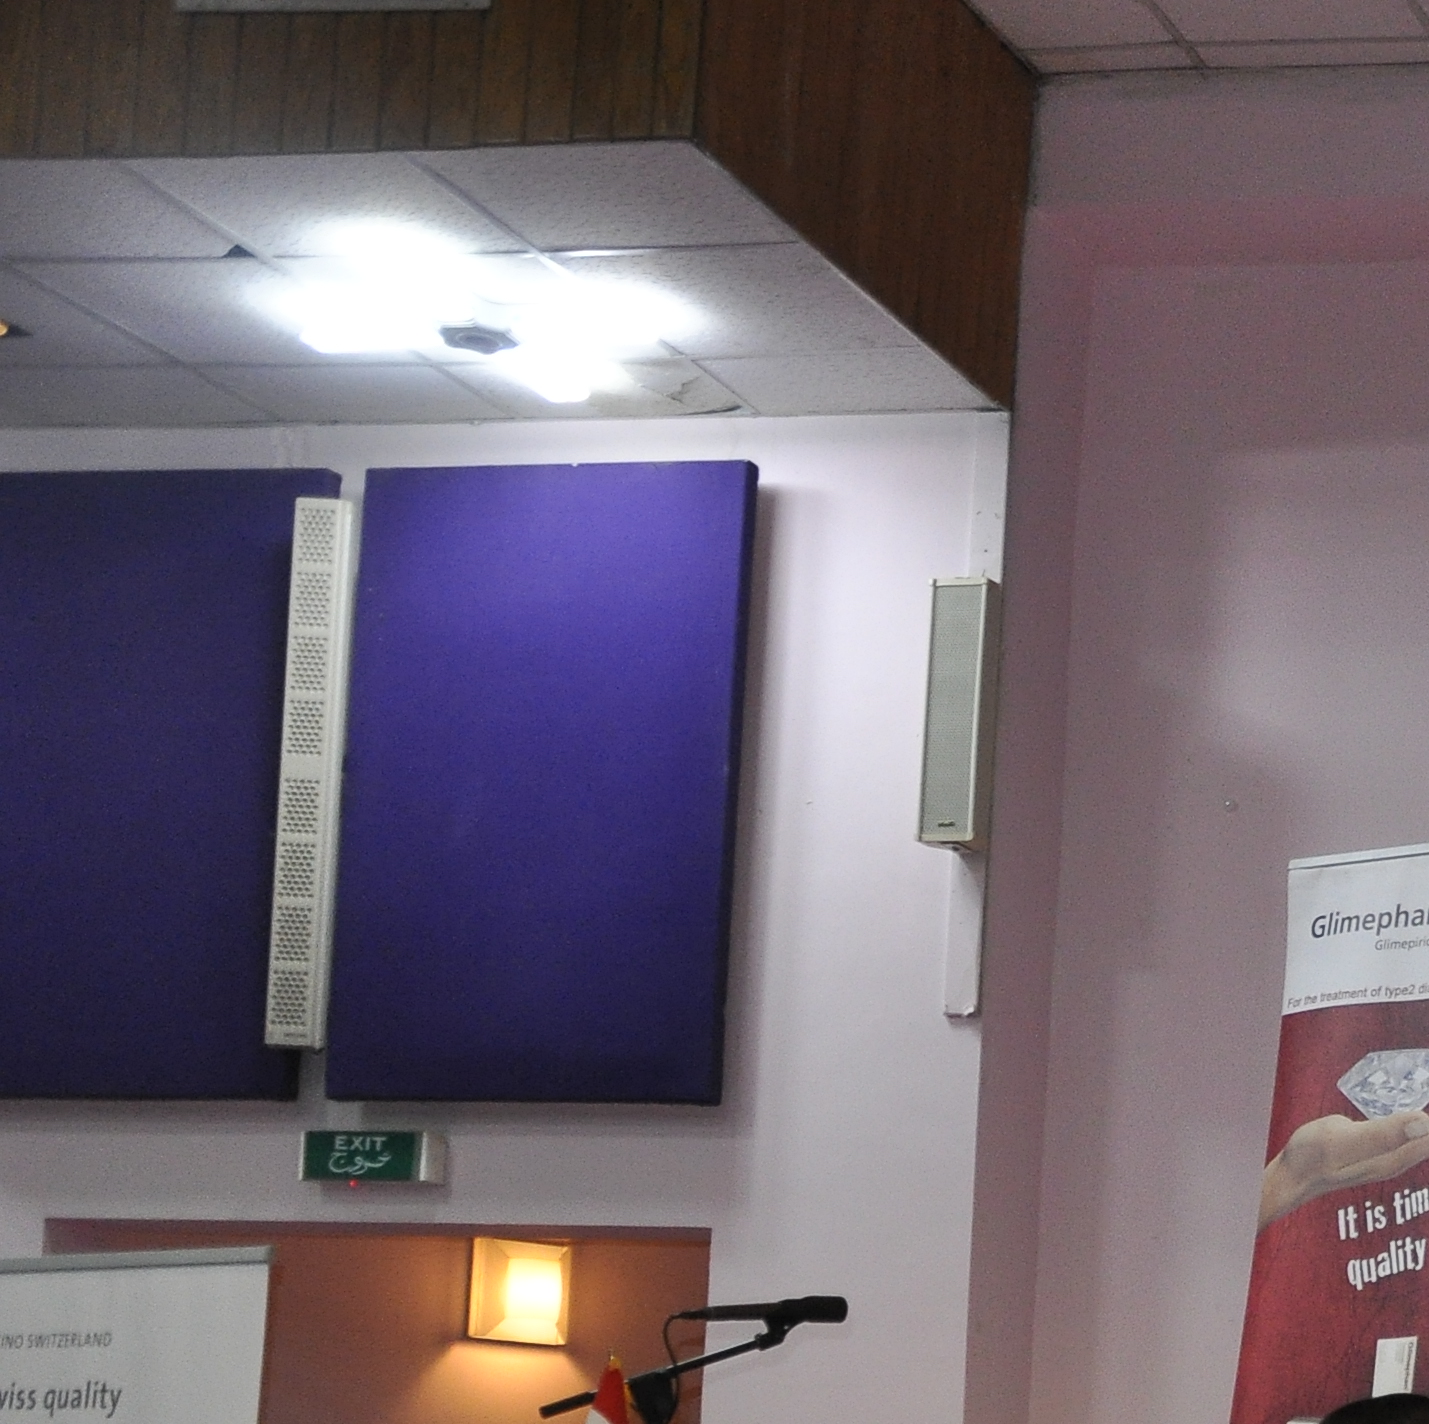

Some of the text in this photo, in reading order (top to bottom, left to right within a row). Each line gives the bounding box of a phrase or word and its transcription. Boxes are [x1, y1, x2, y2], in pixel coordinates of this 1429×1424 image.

[1287, 998, 1303, 1009] For
[1304, 995, 1318, 1006] the
[1320, 989, 1368, 1003] treatment
[1370, 986, 1382, 997] of
[1385, 984, 1416, 999] type2
[334, 1135, 387, 1151] EXIT
[328, 1151, 392, 1175] خروج
[1337, 1205, 1359, 1241] It
[1364, 1200, 1387, 1233] is
[1346, 1236, 1427, 1291] quality
[28, 1331, 113, 1349] SWITZERLAND
[43, 1379, 122, 1419] quality
